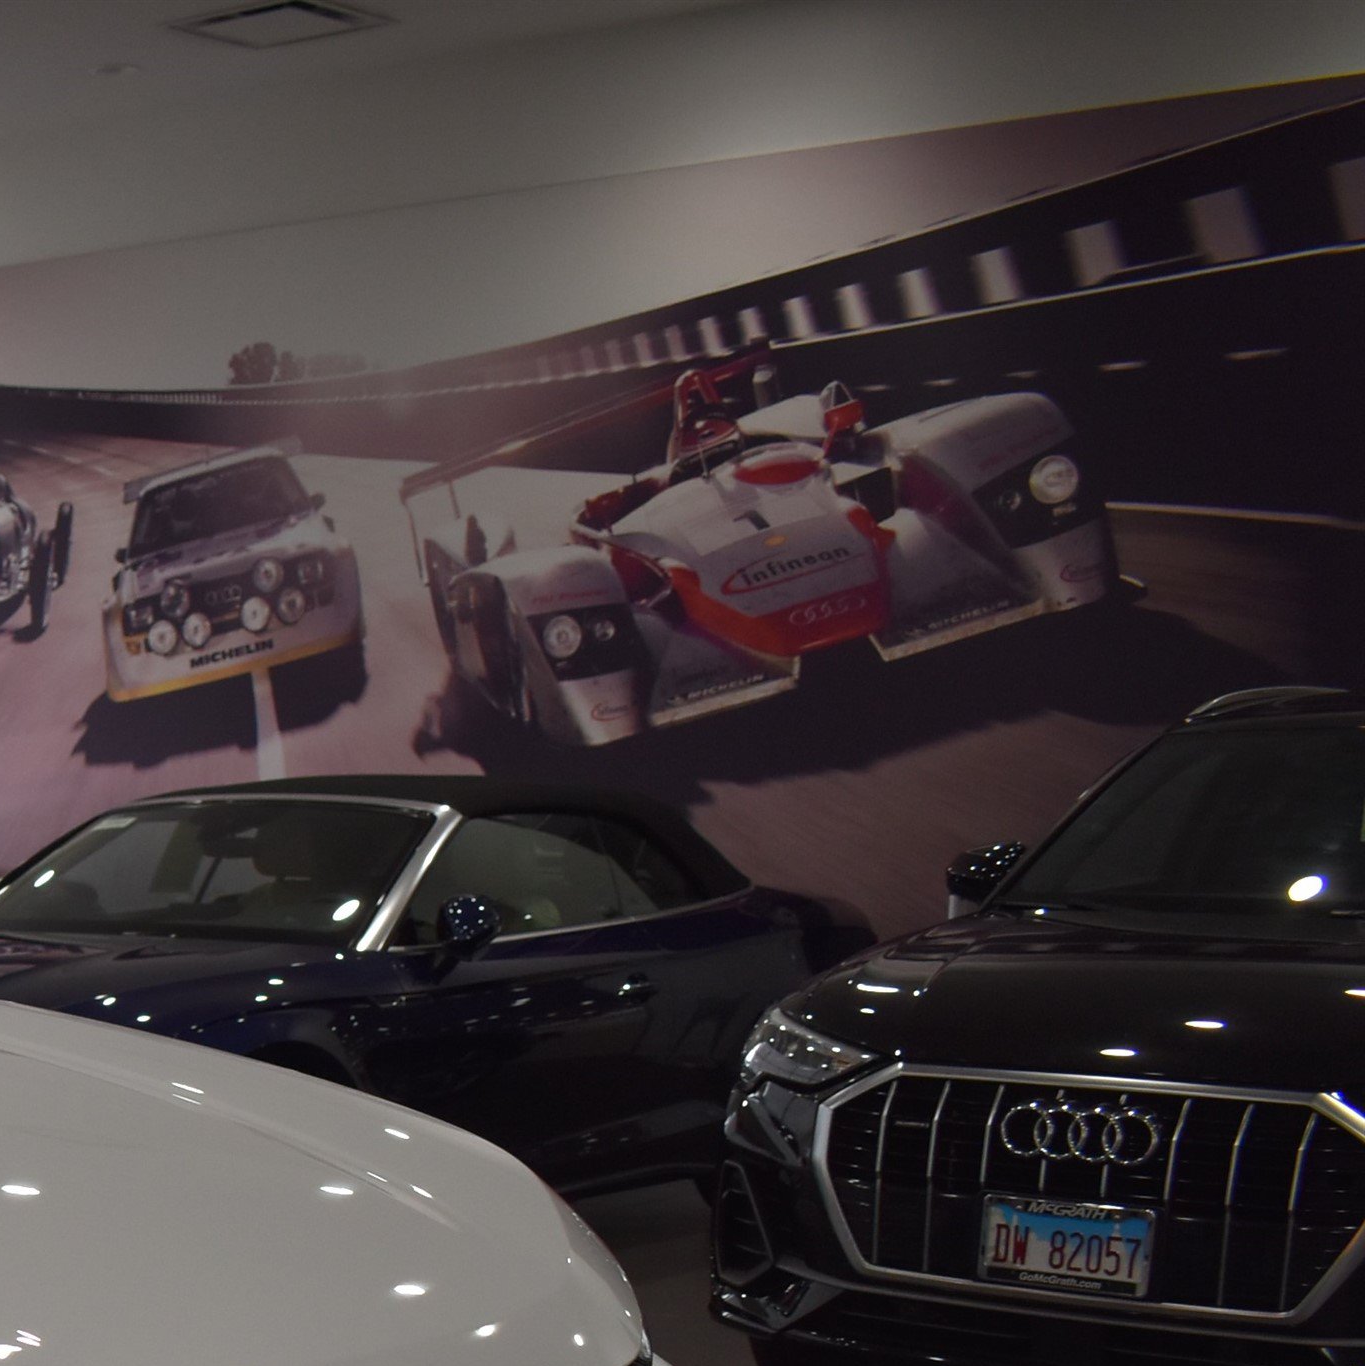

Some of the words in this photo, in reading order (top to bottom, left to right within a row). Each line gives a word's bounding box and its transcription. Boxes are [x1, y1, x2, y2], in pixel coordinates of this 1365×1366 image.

[190, 638, 274, 668] MICHELIN
[993, 1223, 1030, 1265] DW
[1048, 1230, 1142, 1279] 82057
[1018, 1271, 1102, 1290] GoMcGrath.com
